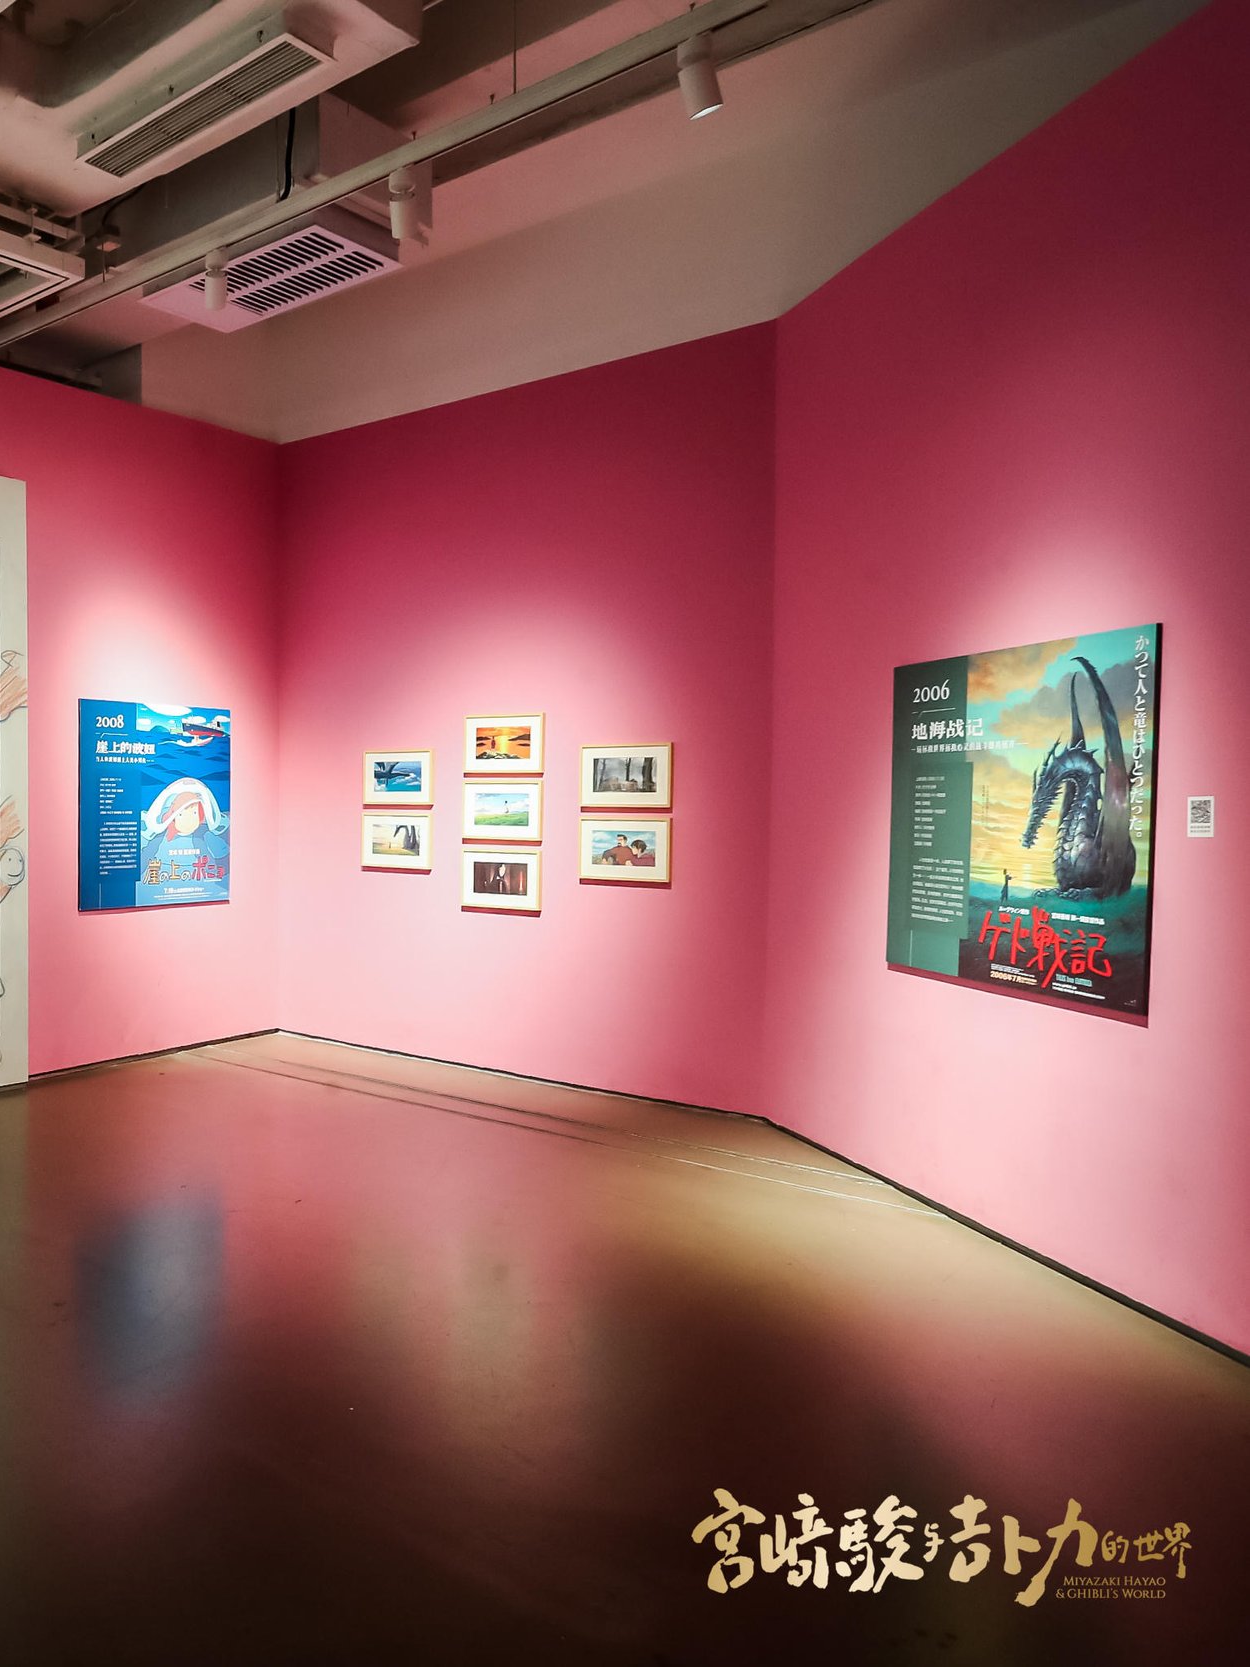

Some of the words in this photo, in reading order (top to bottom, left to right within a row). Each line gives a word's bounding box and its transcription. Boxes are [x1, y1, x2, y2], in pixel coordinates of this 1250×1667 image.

[912, 679, 950, 703] 2006
[95, 714, 125, 729] 2008
[911, 718, 984, 740] 地海战记
[143, 855, 225, 885] 崖の上のポニョ
